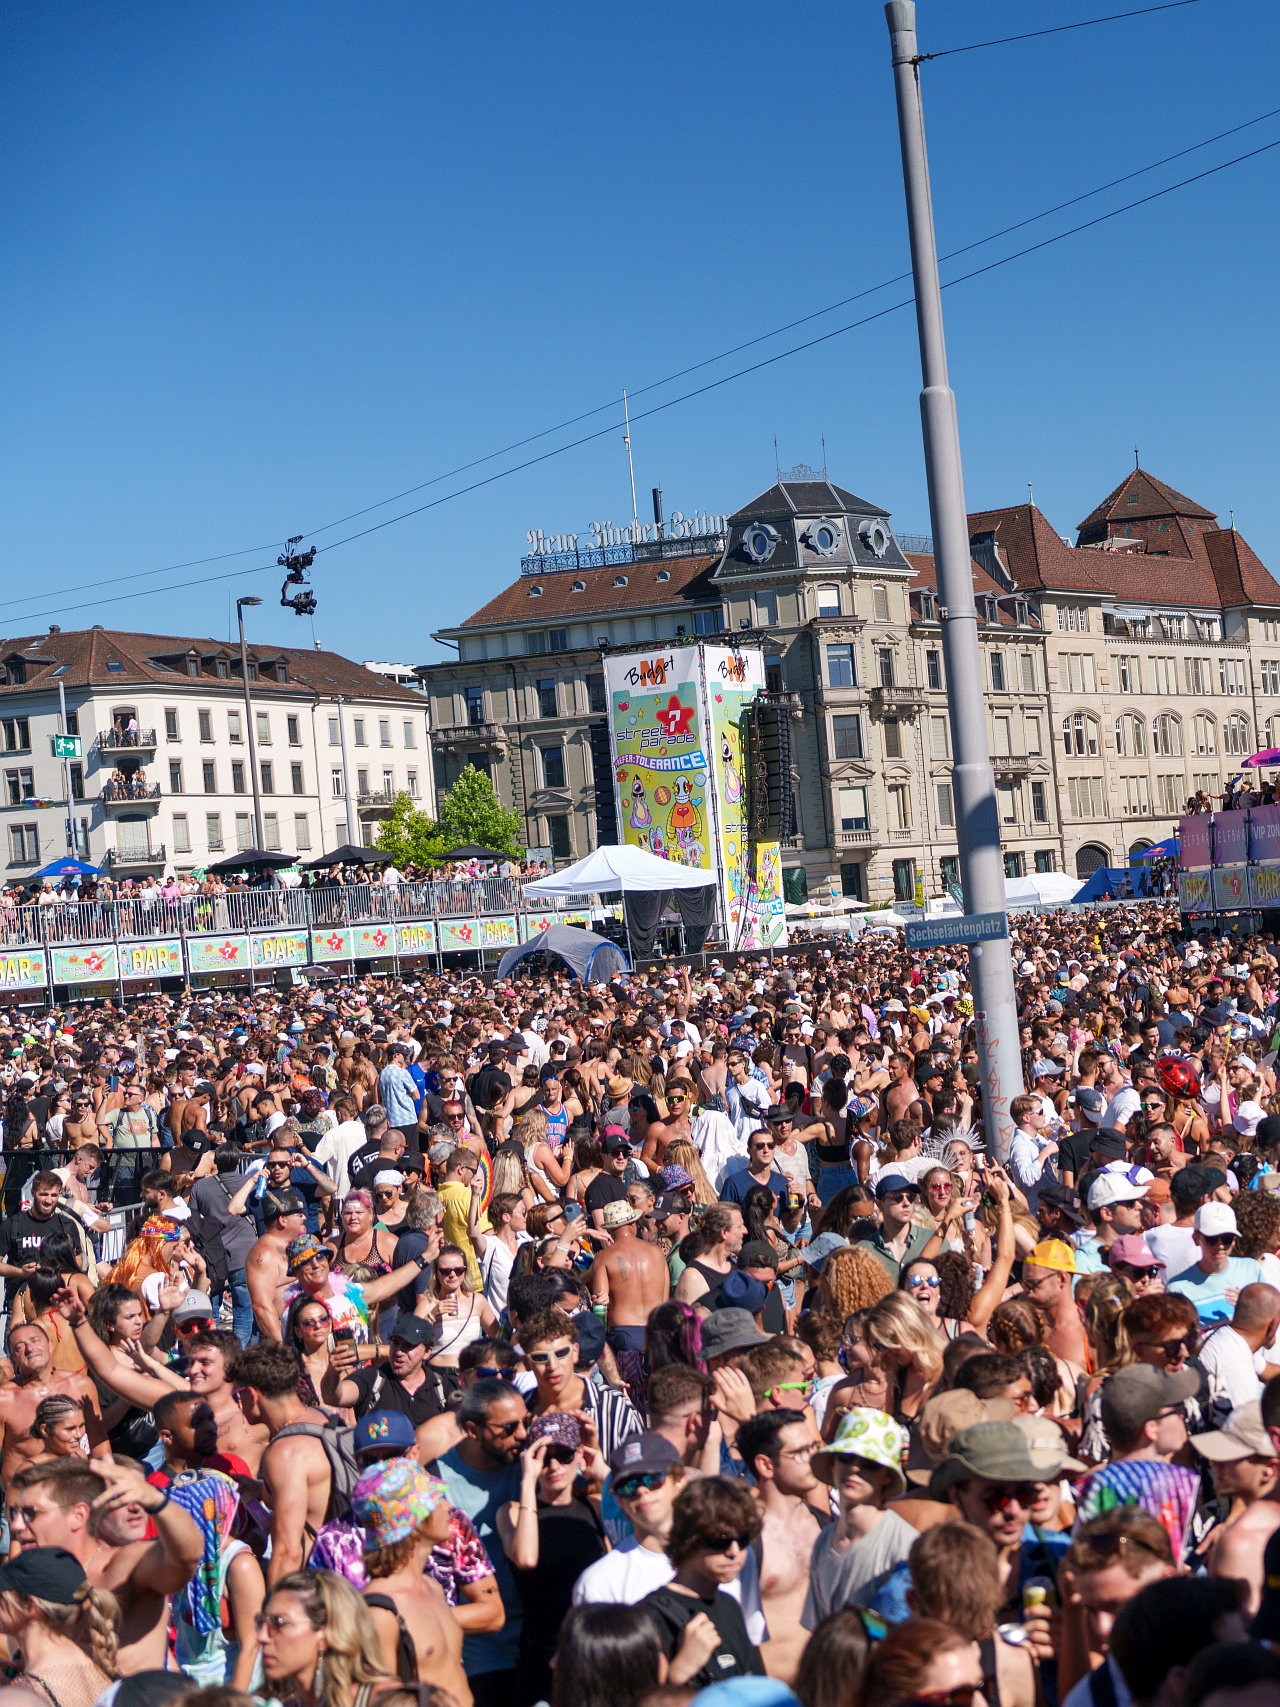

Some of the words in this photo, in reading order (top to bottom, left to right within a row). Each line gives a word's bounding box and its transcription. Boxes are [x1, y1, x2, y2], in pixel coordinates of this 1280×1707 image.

[527, 528, 578, 556] Neue
[585, 517, 664, 549] Zürcher
[624, 655, 674, 686] Budget
[616, 724, 670, 741] street
[639, 730, 696, 752] parade
[1253, 826, 1266, 839] VIP
[1185, 877, 1204, 903] BAR
[1257, 871, 1279, 898] BAR
[401, 928, 425, 949] BAR
[486, 921, 509, 942] BAR
[909, 919, 1002, 942] Sechseläutenplatz
[131, 948, 169, 972] BAR
[263, 937, 298, 964] BAR
[22, 1236, 42, 1248] HU
